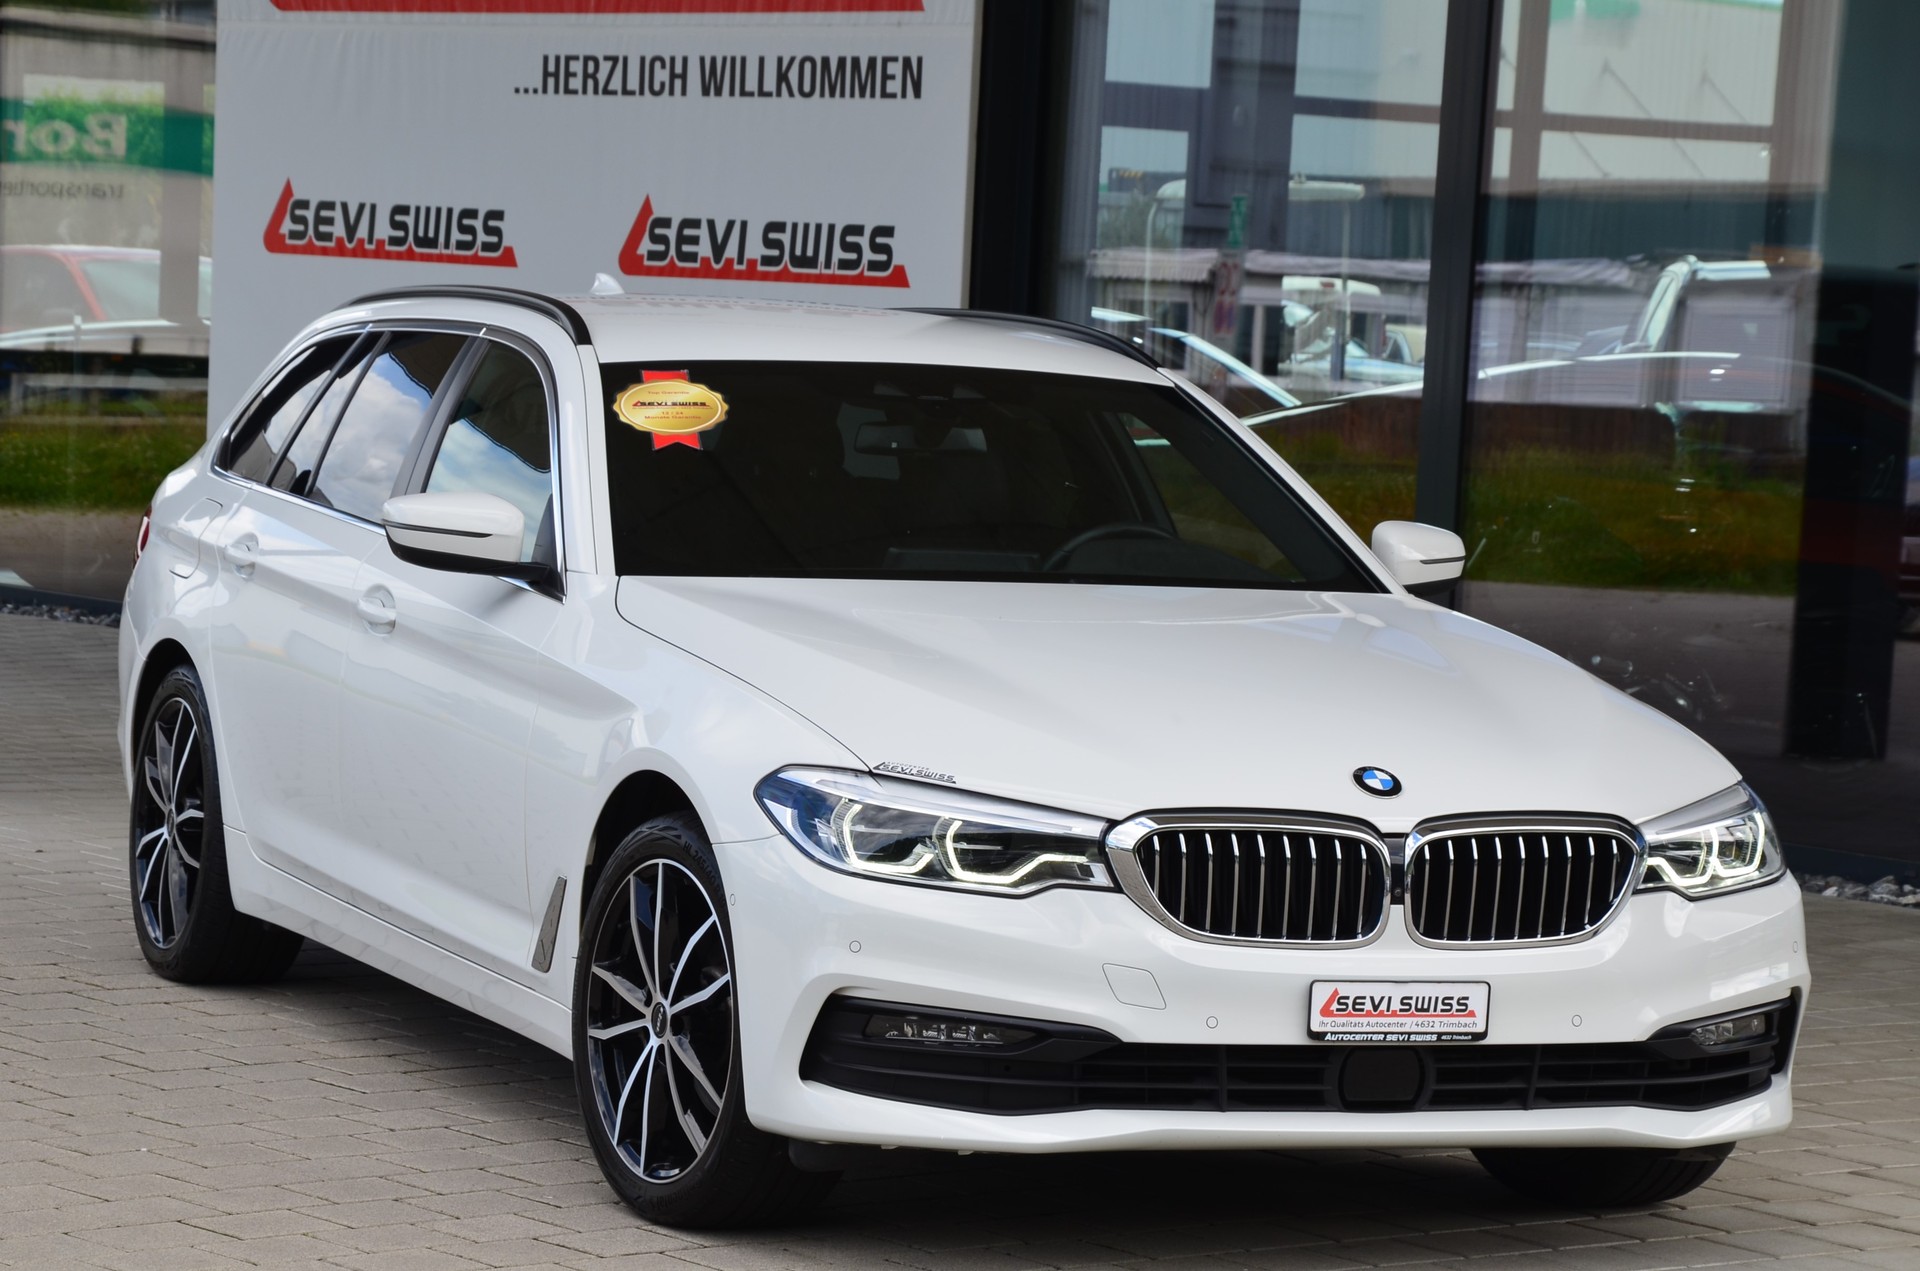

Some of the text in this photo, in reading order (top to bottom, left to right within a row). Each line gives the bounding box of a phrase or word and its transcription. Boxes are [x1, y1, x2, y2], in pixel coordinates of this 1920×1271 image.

[513, 54, 924, 100] ...HERZLICH WILLKOMMEN
[287, 199, 505, 254] SEVI SWISS
[644, 216, 896, 274] SEVI SWISS
[882, 764, 955, 781] SEVI SWISS
[1335, 995, 1470, 1013] SEVI SWISS
[1318, 1020, 1329, 1028] Ihr
[1365, 1020, 1408, 1029] Autocenter
[1414, 1020, 1436, 1029] 4632
[1438, 1020, 1478, 1029] Trimbach
[1385, 1033, 1409, 1042] SEVI
[1409, 1034, 1438, 1042] SWISS
